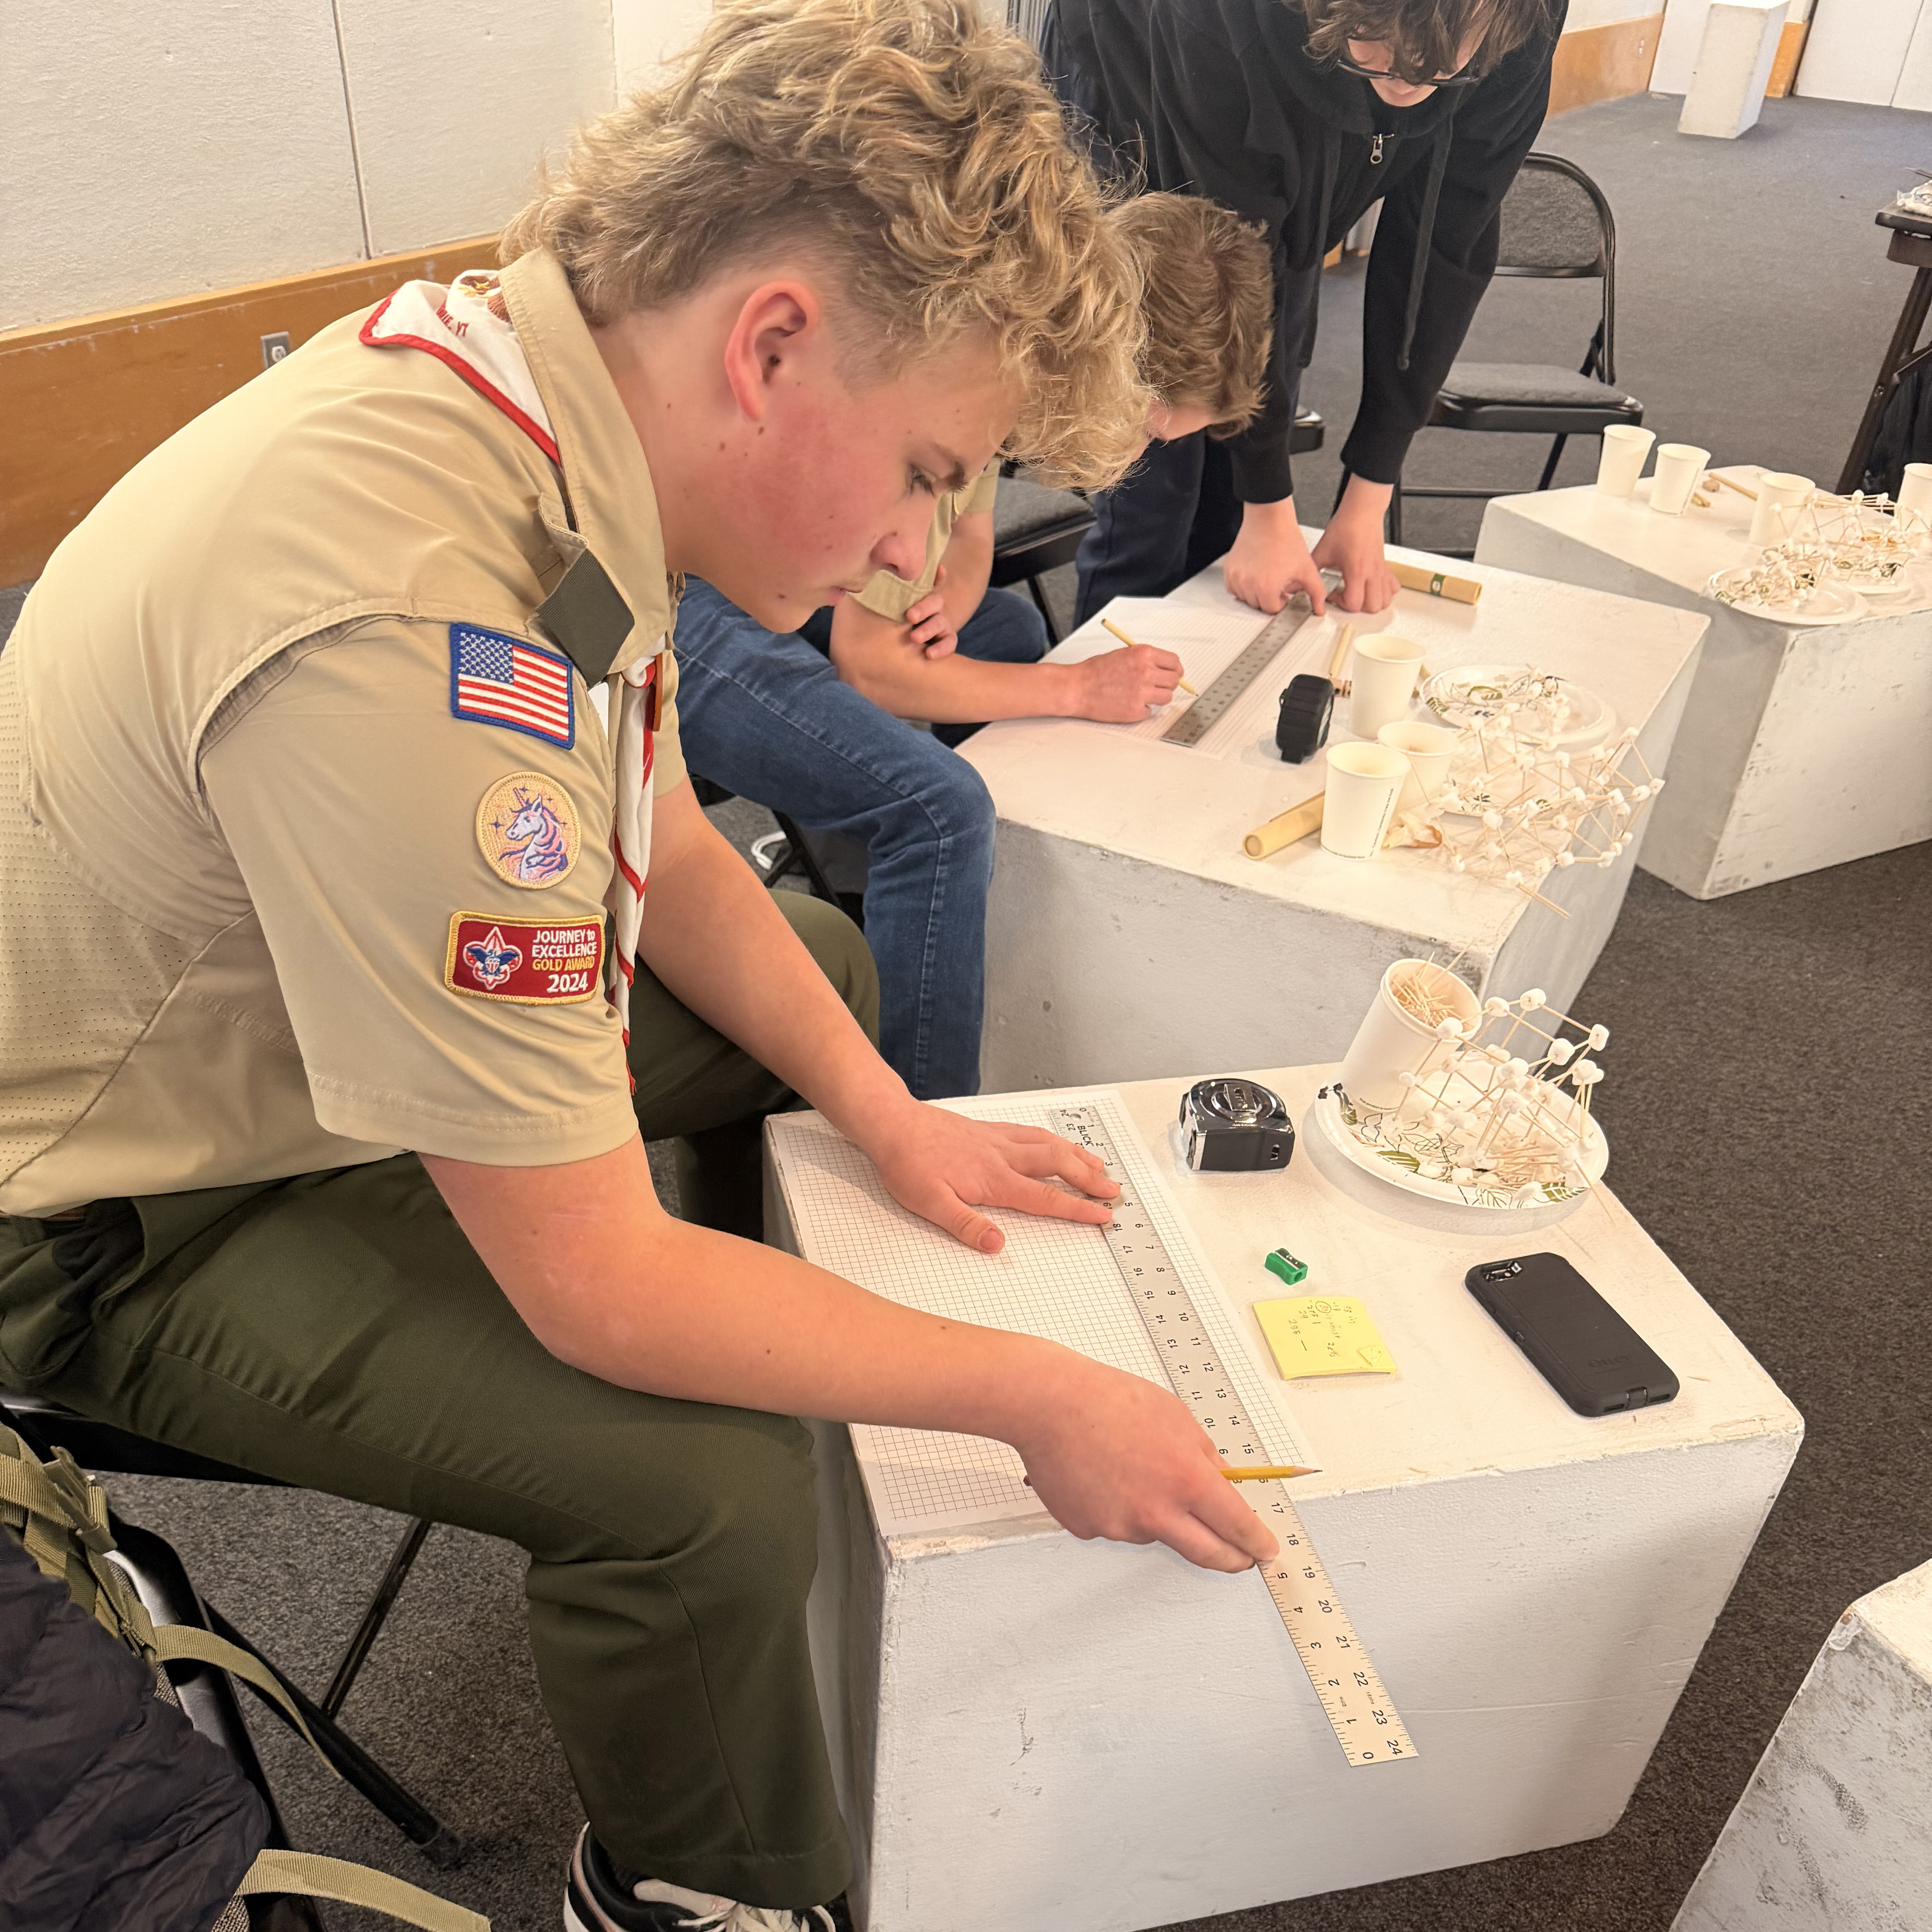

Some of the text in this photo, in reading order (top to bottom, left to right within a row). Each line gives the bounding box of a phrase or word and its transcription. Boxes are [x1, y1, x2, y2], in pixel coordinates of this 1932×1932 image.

[455, 322, 469, 337] VT
[533, 929, 595, 943] JOURNEY to
[531, 942, 597, 958] EXCELLENCE
[532, 956, 595, 971] GOLD AWARD
[546, 971, 589, 993] 2024
[1077, 1126, 1094, 1146] BLICK
[1113, 1223, 1123, 1232] 18
[1123, 1246, 1133, 1254] 17
[1133, 1267, 1144, 1276] 16
[1144, 1291, 1155, 1300] 15
[1156, 1315, 1166, 1324] 14
[1167, 1339, 1178, 1348] 13
[1179, 1364, 1190, 1374] 12
[1191, 1391, 1203, 1401] 11
[1204, 1418, 1216, 1428] 10
[1178, 1312, 1189, 1321] 10
[1191, 1337, 1201, 1346] 11
[1202, 1362, 1214, 1372] 12
[1215, 1388, 1227, 1398] 13
[1228, 1415, 1240, 1426] 14
[1242, 1443, 1254, 1454] 15
[1271, 1502, 1284, 1513] 17
[1287, 1533, 1299, 1546] 18
[1302, 1566, 1316, 1578] 19
[1318, 1600, 1332, 1613] 20
[1335, 1636, 1351, 1648] 21
[1353, 1671, 1369, 1687] 22
[1372, 1710, 1388, 1725] 23
[1386, 1740, 1403, 1756] 24
